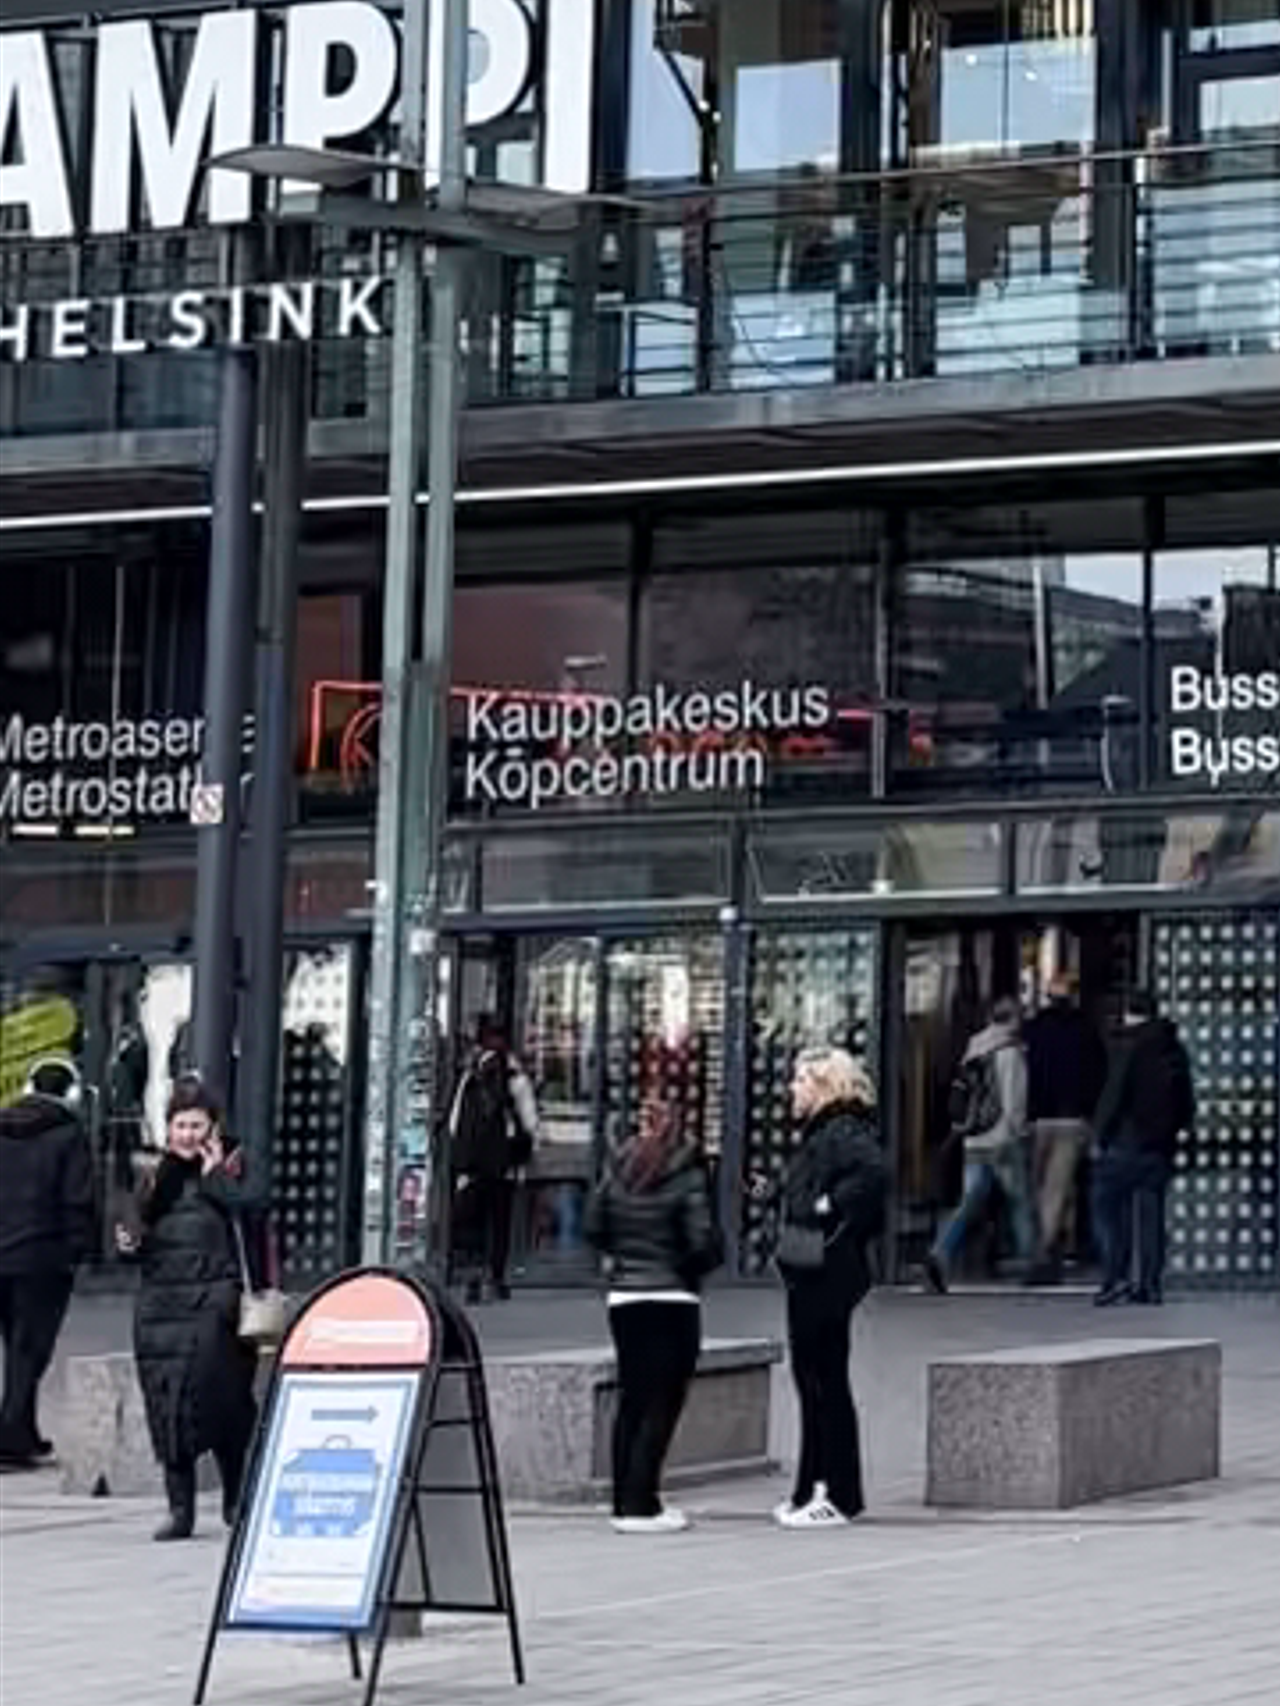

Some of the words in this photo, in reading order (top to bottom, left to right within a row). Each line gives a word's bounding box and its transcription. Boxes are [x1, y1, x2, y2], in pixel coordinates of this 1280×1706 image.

[0, 275, 381, 362] HELSINK
[466, 681, 830, 746] Kauppakeskus
[466, 747, 764, 808] Köpcentrum
